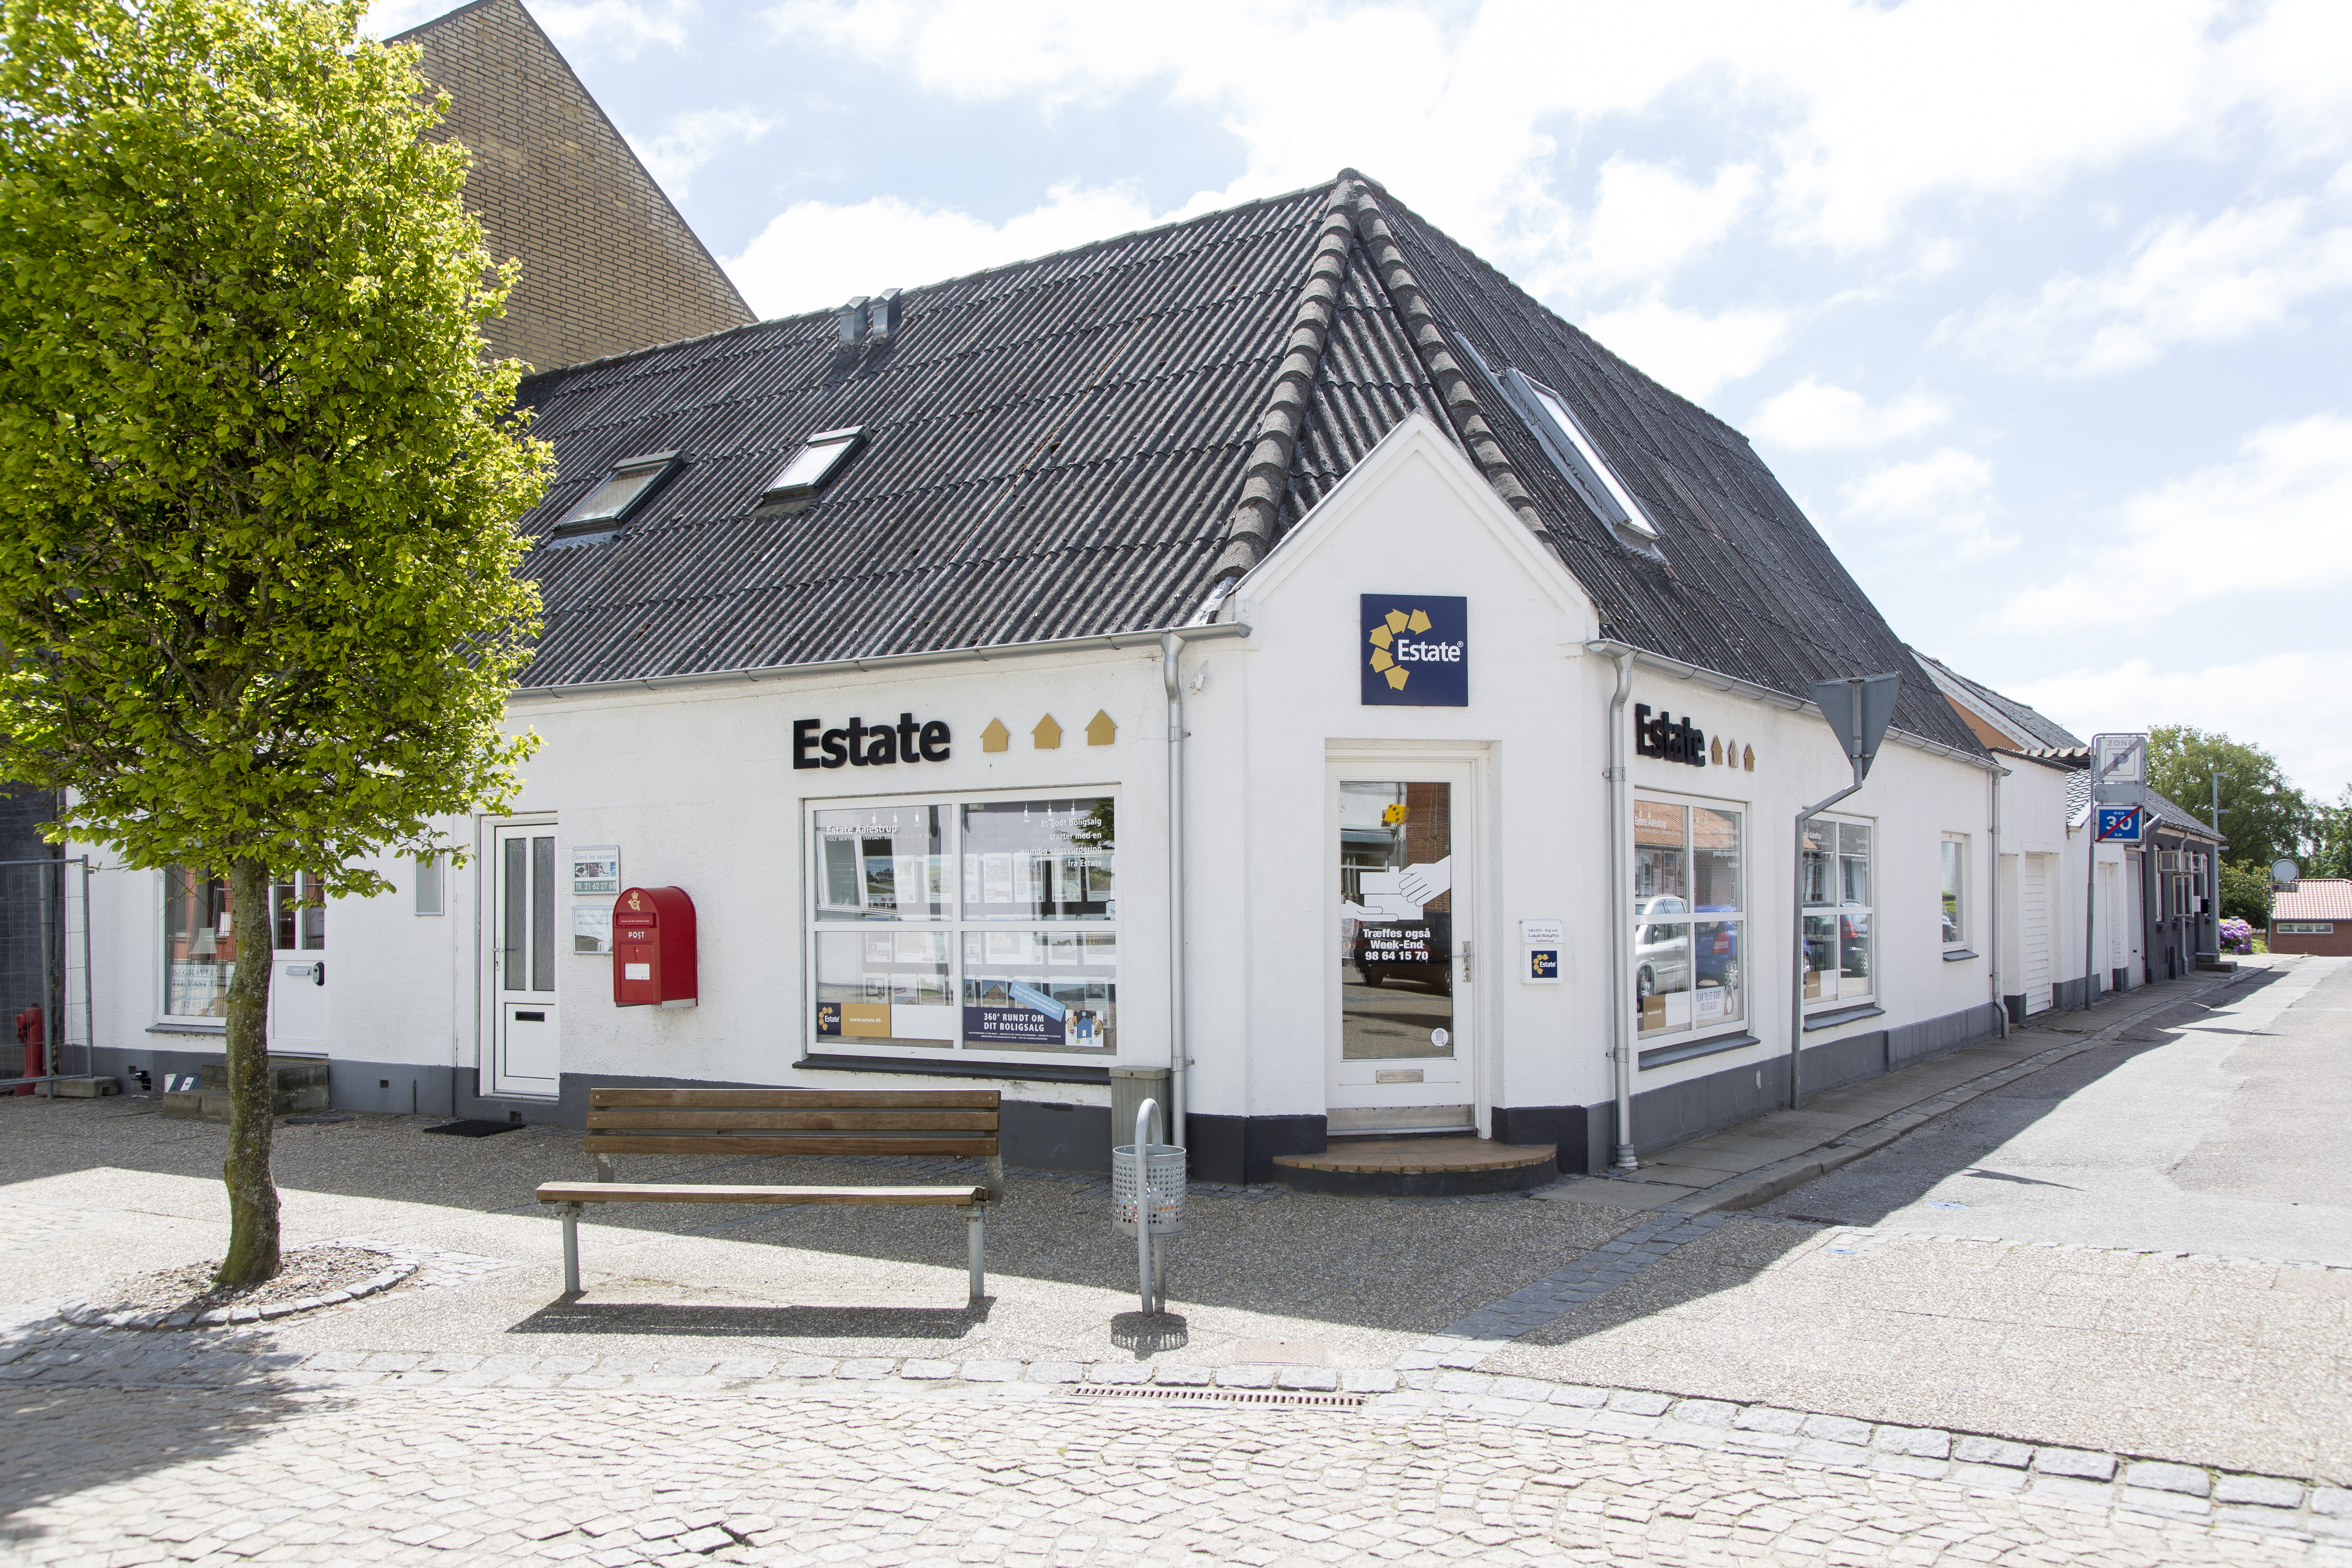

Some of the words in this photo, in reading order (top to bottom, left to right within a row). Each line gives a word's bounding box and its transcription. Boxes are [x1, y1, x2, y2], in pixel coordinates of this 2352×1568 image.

[1635, 703, 1706, 767] Estate
[793, 713, 951, 769] Estate
[2111, 752, 2129, 771] P
[1050, 819, 1067, 829] godt
[1069, 817, 1102, 827] boligsalg
[1635, 816, 1648, 826] Estate
[1648, 817, 1666, 829] Aalestrup
[2105, 815, 2132, 831] 30
[826, 825, 853, 835] Estate
[855, 824, 898, 834] Aalestrup
[1075, 831, 1091, 840] med
[1020, 846, 1047, 856] grundig
[1049, 845, 1102, 855] salgsvurdering
[1067, 859, 1078, 867] fra
[1080, 859, 1102, 867] Estate
[628, 931, 645, 939] POST
[1363, 929, 1402, 938] Træffes
[1405, 928, 1430, 939] også
[1370, 940, 1423, 949] Week-End
[1365, 951, 1379, 960] 98
[1382, 951, 1396, 960] 64
[1399, 951, 1412, 960] 15
[1415, 951, 1428, 960] 70
[1029, 991, 1042, 1002] boligsalg
[1709, 991, 1713, 1000] ET
[1700, 1000, 1717, 1012] BOLIGSALG?
[984, 1013, 1000, 1021] 360°
[1002, 1013, 1029, 1022] RUNDT
[1031, 1014, 1044, 1022] OM
[984, 1022, 997, 1030] DIT
[1000, 1022, 1044, 1032] BOLIGSALG
